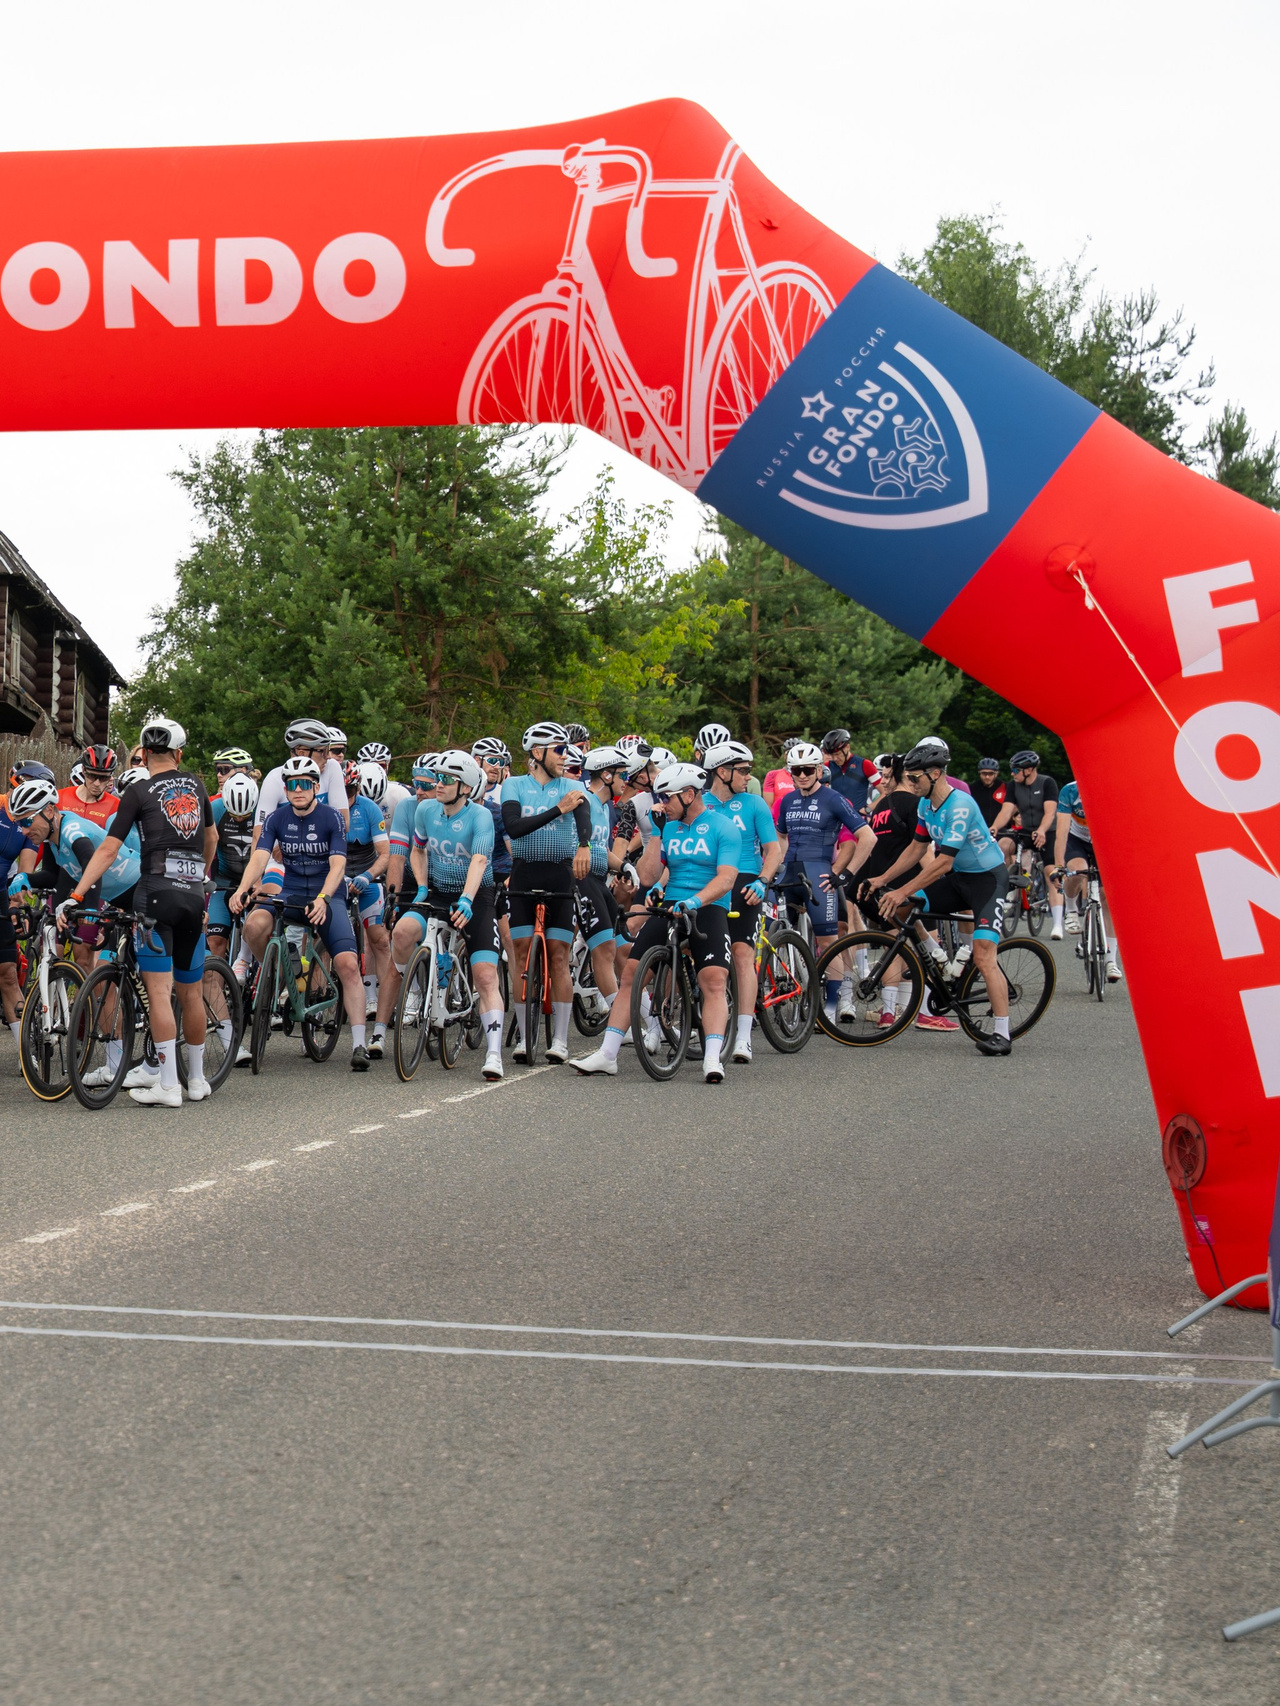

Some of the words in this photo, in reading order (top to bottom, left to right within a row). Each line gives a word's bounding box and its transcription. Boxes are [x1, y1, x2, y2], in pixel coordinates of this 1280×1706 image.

[834, 327, 887, 387] РОССИЯ
[807, 379, 881, 466] GRAN
[824, 391, 899, 479] FONDO
[756, 430, 804, 488] RUSSIA
[785, 811, 821, 820] SERPANTIN
[947, 808, 969, 842] RCA
[427, 836, 472, 858] RCA
[668, 838, 711, 856] RCA
[967, 828, 989, 855] RCA
[176, 860, 197, 875] 318
[439, 855, 464, 866] TEAM
